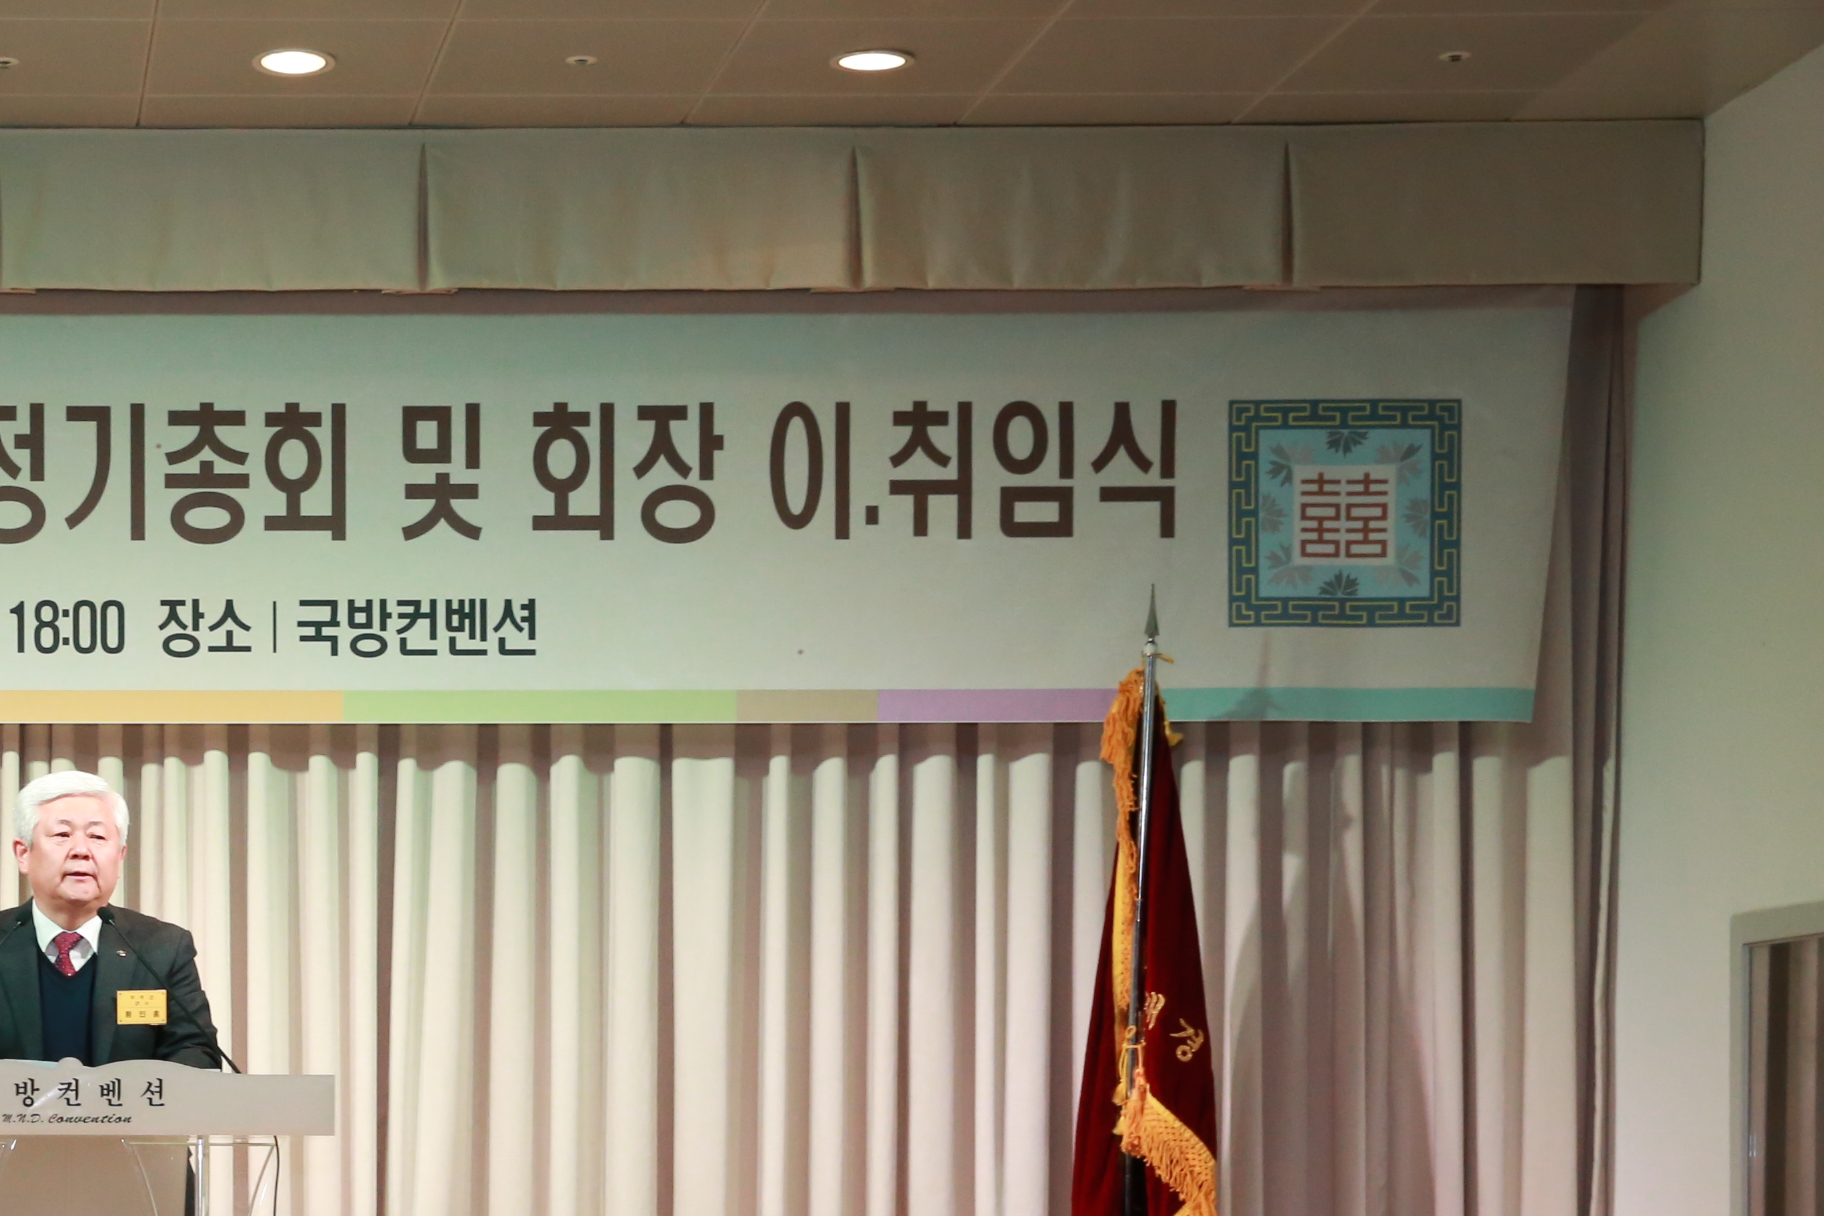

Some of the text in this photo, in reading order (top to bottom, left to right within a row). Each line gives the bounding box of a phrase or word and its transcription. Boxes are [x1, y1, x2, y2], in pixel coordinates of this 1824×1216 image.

[401, 402, 483, 542] 및
[531, 401, 725, 545] 회장
[769, 399, 1177, 541] 이.취임식
[9, 599, 126, 655] 18:00
[157, 598, 253, 659] 장소
[296, 597, 537, 659] 국방컨벤션
[48, 1112, 132, 1124] Convention
